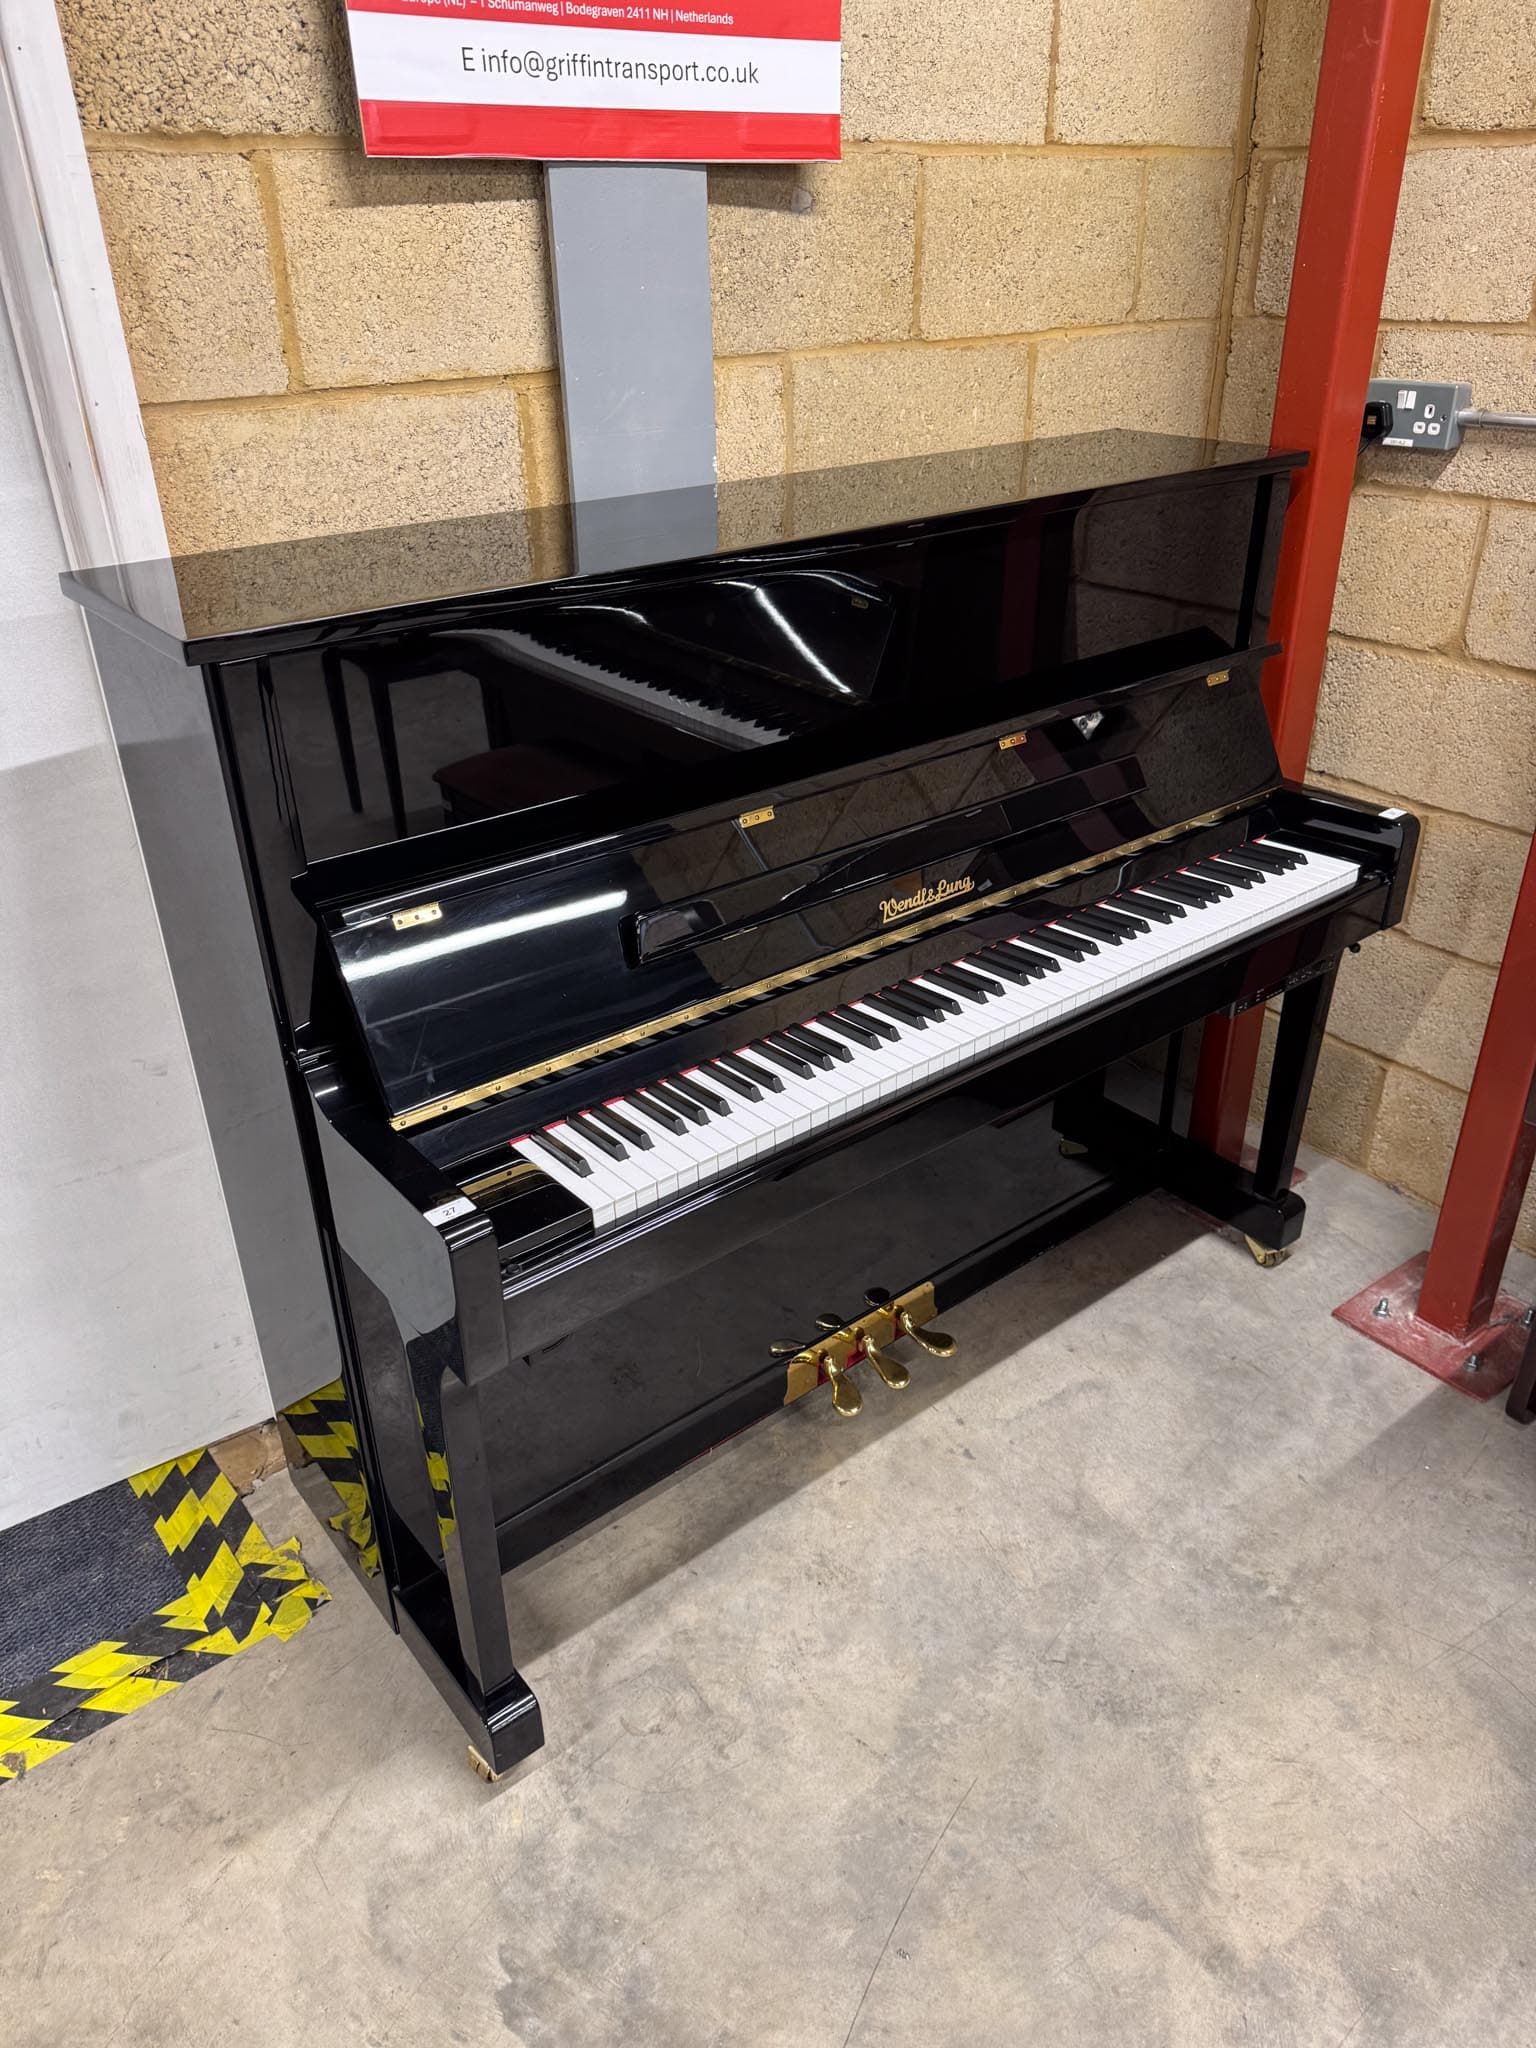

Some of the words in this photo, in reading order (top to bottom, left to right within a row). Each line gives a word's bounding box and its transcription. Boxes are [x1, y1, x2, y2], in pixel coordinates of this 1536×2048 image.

[487, 0, 559, 15] Schumanweg
[566, 2, 625, 18] Bodegraven
[627, 7, 650, 18] 2411
[653, 9, 669, 20] NH
[675, 10, 734, 25] Netherlands
[461, 47, 475, 72] E
[481, 48, 760, 86] info@griffintransport.co.uk
[442, 1206, 456, 1217] 27
